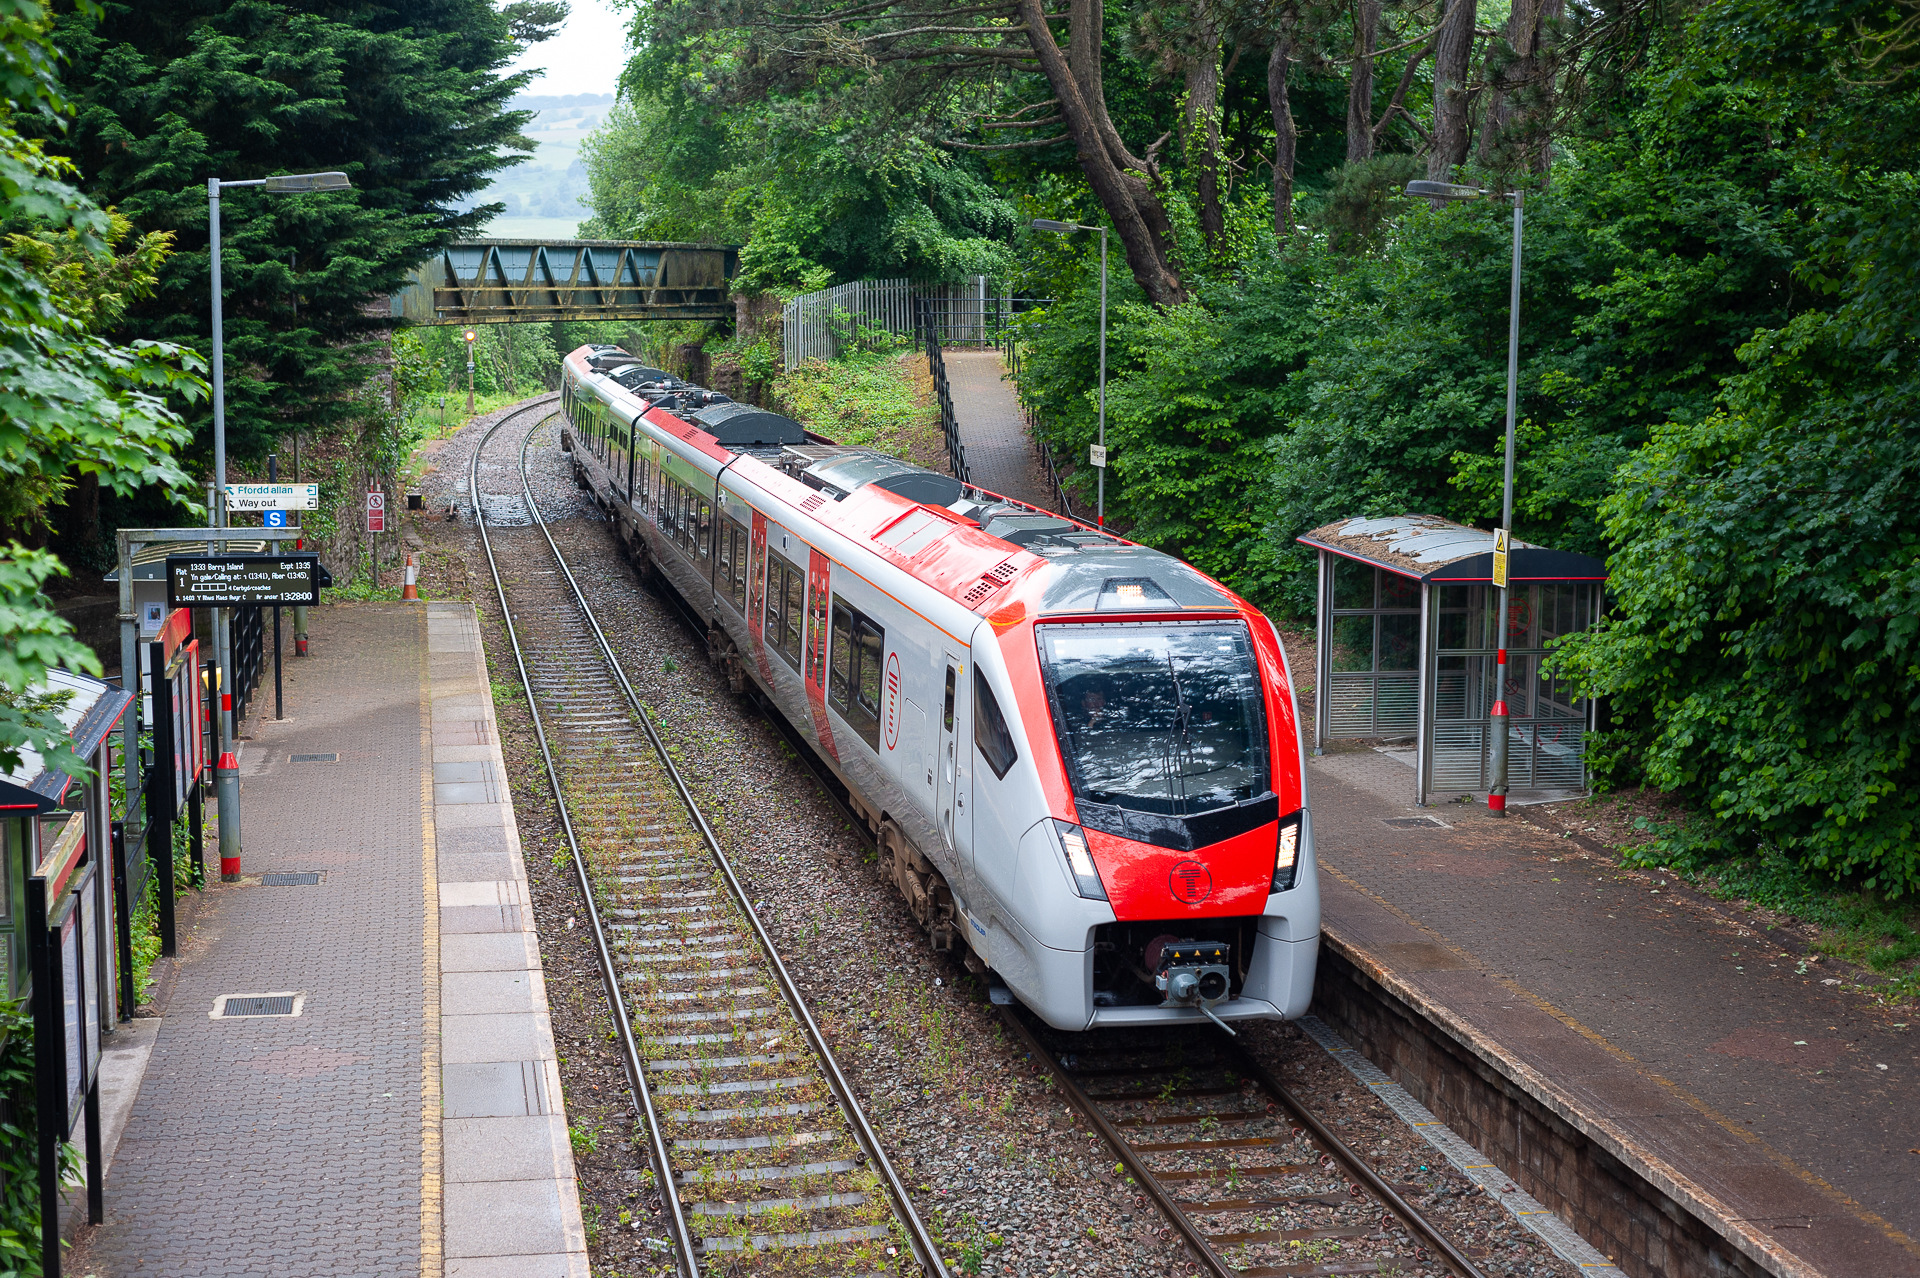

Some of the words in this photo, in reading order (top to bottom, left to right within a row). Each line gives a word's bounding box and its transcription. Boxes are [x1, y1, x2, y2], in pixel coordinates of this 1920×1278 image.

[238, 486, 269, 494] Ffordd
[270, 486, 293, 494] allan
[239, 499, 259, 508] Way
[261, 499, 277, 507] out
[269, 512, 281, 527] S
[190, 563, 206, 571] 13:33
[207, 563, 226, 572] Barry
[226, 562, 244, 571] Island
[280, 562, 294, 571] Expt
[295, 561, 311, 570] 13:35
[175, 568, 188, 576] Plat
[190, 573, 199, 581] Yn
[179, 577, 185, 588] 1
[280, 591, 313, 601] 13:28:00
